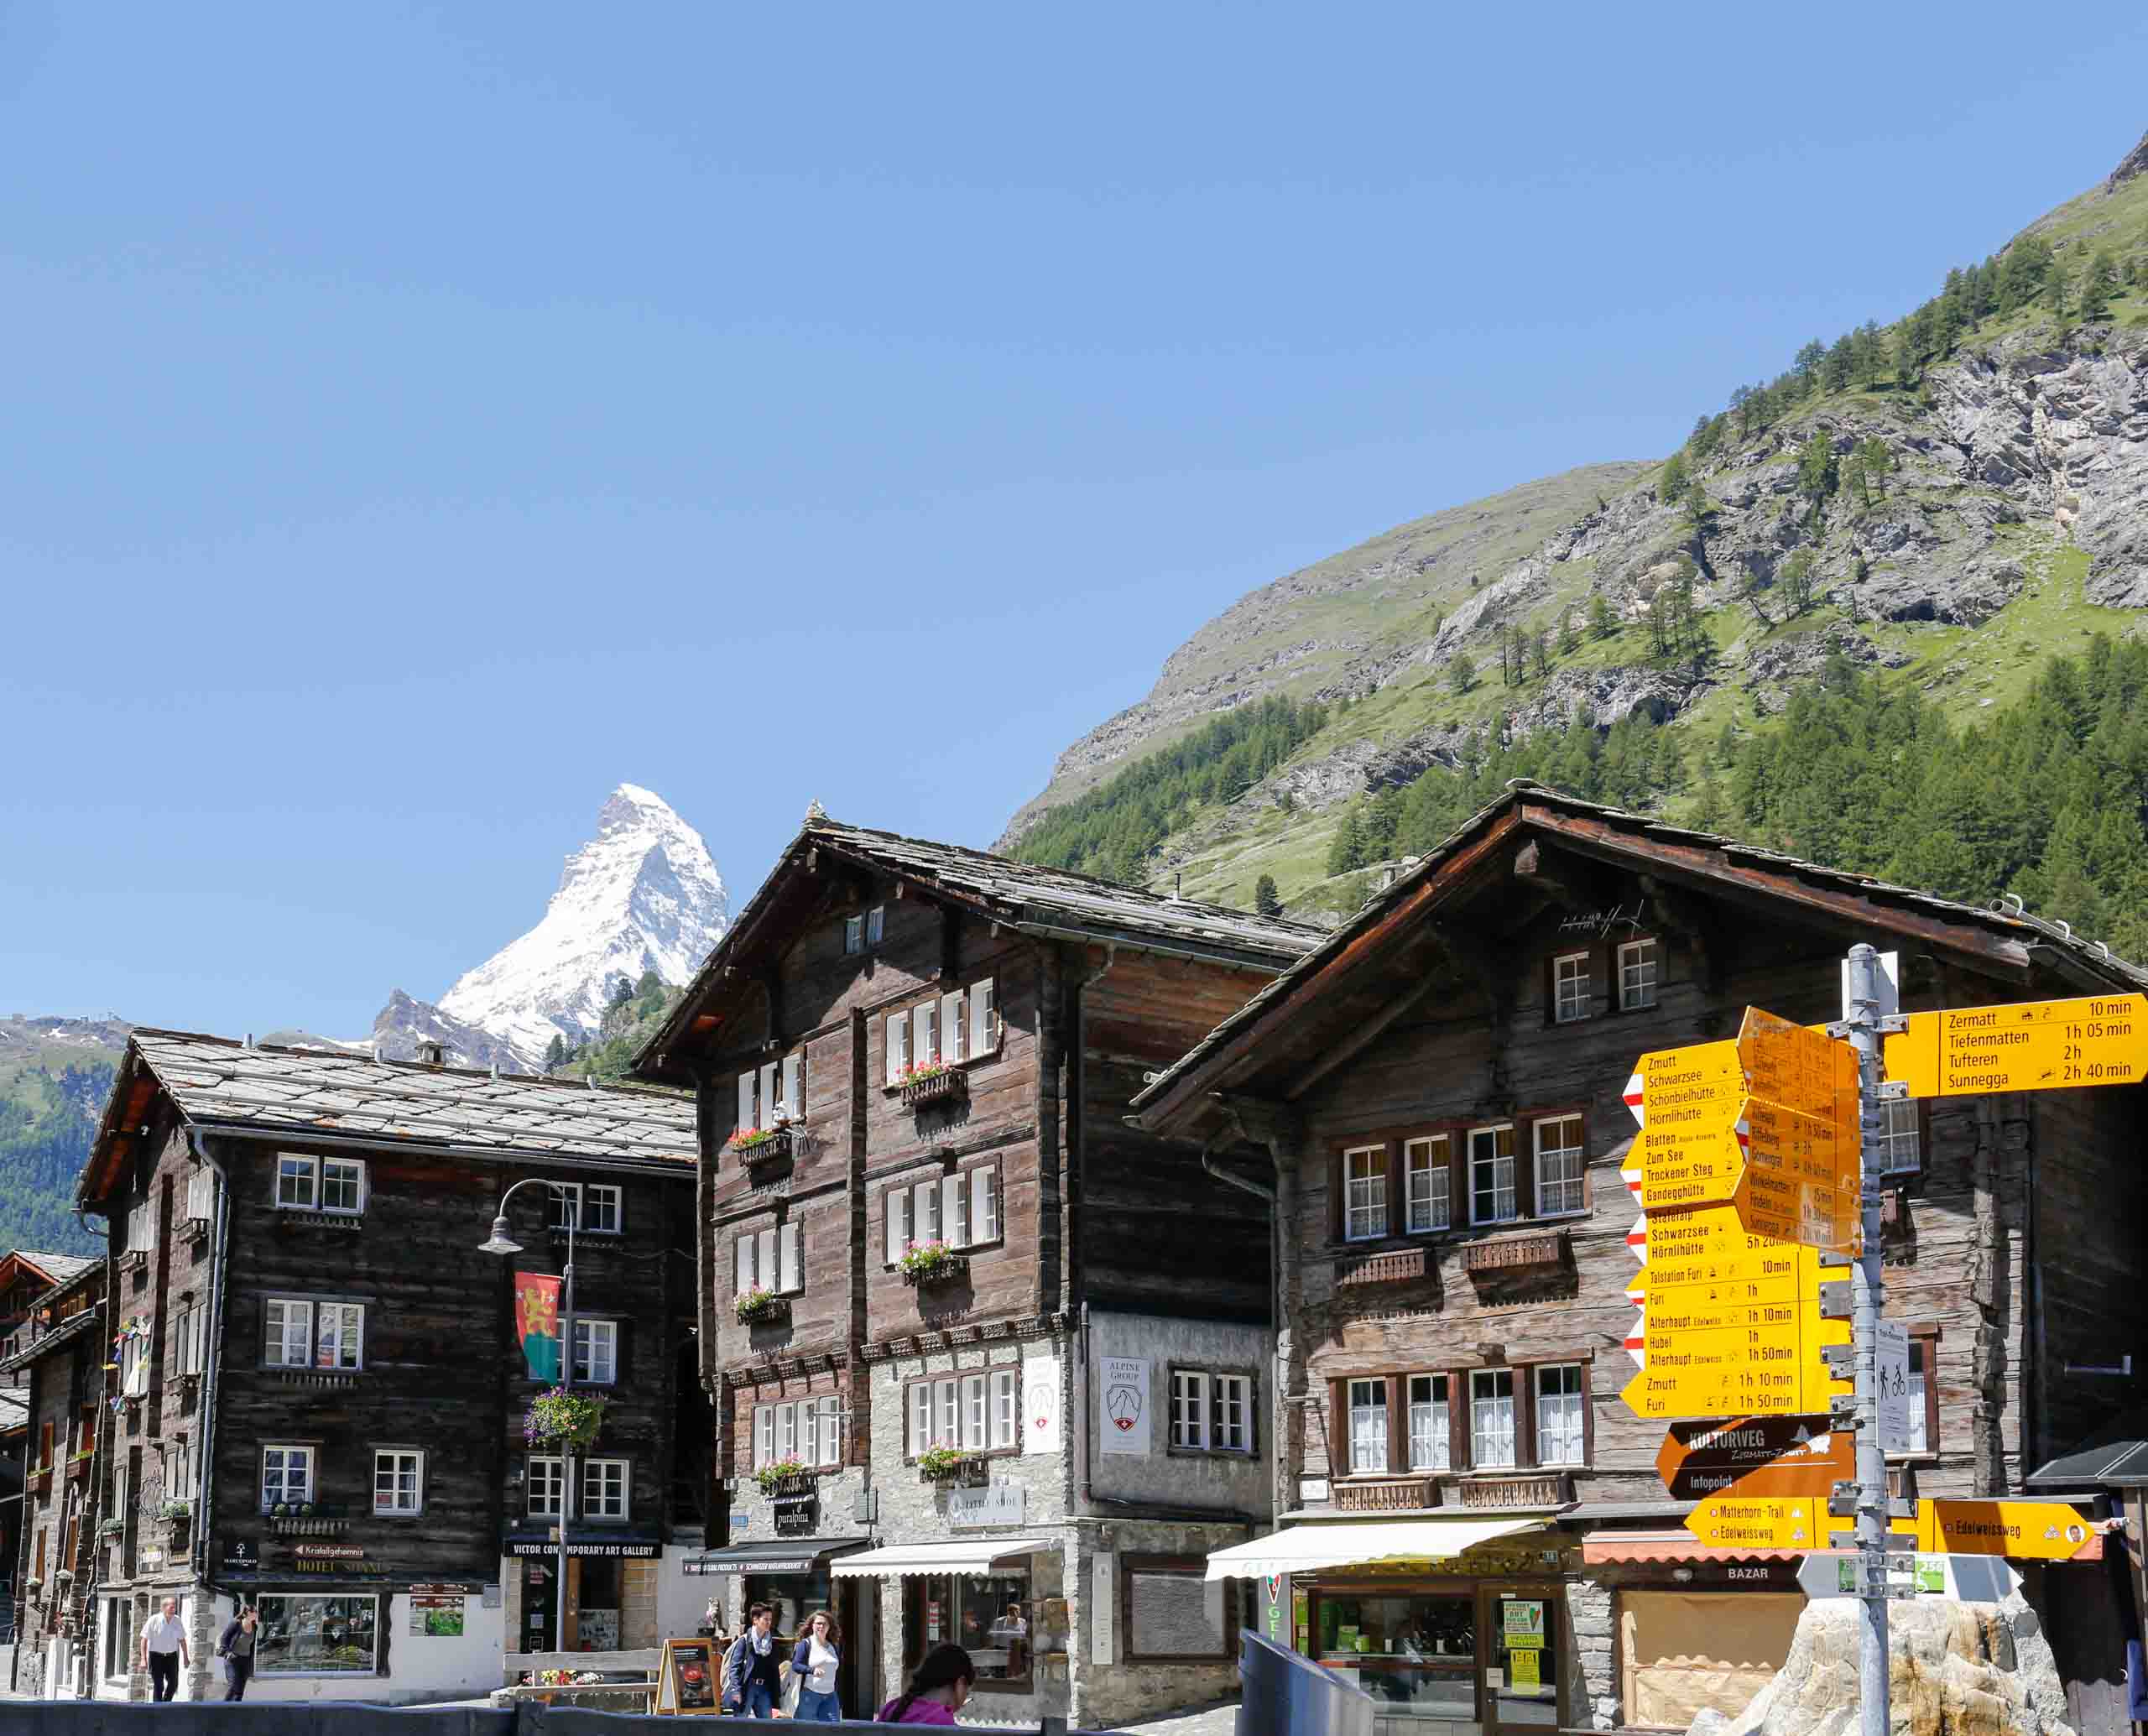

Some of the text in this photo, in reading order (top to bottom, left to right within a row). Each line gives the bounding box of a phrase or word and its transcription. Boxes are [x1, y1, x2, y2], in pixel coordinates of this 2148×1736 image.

[1949, 1013, 1996, 1029] Zermatt
[1949, 1031, 2029, 1049] Tiefenmatten
[1648, 1056, 1677, 1071] Zmutt
[1949, 1053, 1998, 1068] Tufteren
[1649, 1071, 1702, 1088] Schwarzsee
[1949, 1071, 2008, 1089] Sunnegga
[1649, 1087, 1715, 1108] Schönbielhütte
[1650, 1108, 1702, 1125] Hörnlihütte
[1646, 1133, 1676, 1149] Blatten
[1646, 1150, 1684, 1165] Zum See
[1647, 1163, 1713, 1183] Trockener Steg
[1647, 1184, 1705, 1202] Gandegghütte
[1652, 1226, 1708, 1242] Schwarzsee
[1652, 1243, 1704, 1259] Hörnlihütte
[1650, 1269, 1685, 1285] Talstation
[1687, 1268, 1702, 1281] Furi
[1650, 1293, 1664, 1306] Furi
[1650, 1316, 1691, 1330] Alterhaupt
[1650, 1335, 1671, 1349] Hubel
[1110, 1362, 1140, 1371] ALPINE
[1650, 1352, 1692, 1367] Alterhaupt
[1110, 1372, 1140, 1382] GROUP
[1647, 1378, 1677, 1391] Zmutt
[1647, 1398, 1666, 1411] Furi
[1690, 1429, 1765, 1451] KULTURWEG
[1691, 1474, 1733, 1491] Infopoint
[778, 1508, 809, 1528] puralpina
[1721, 1525, 1773, 1541] Edelweissweg
[1956, 1520, 2020, 1539] Edelweissweg
[514, 1545, 654, 1556] VICTOR CONMPORARY ART GALLERY
[1728, 1568, 1768, 1578] BAZAR
